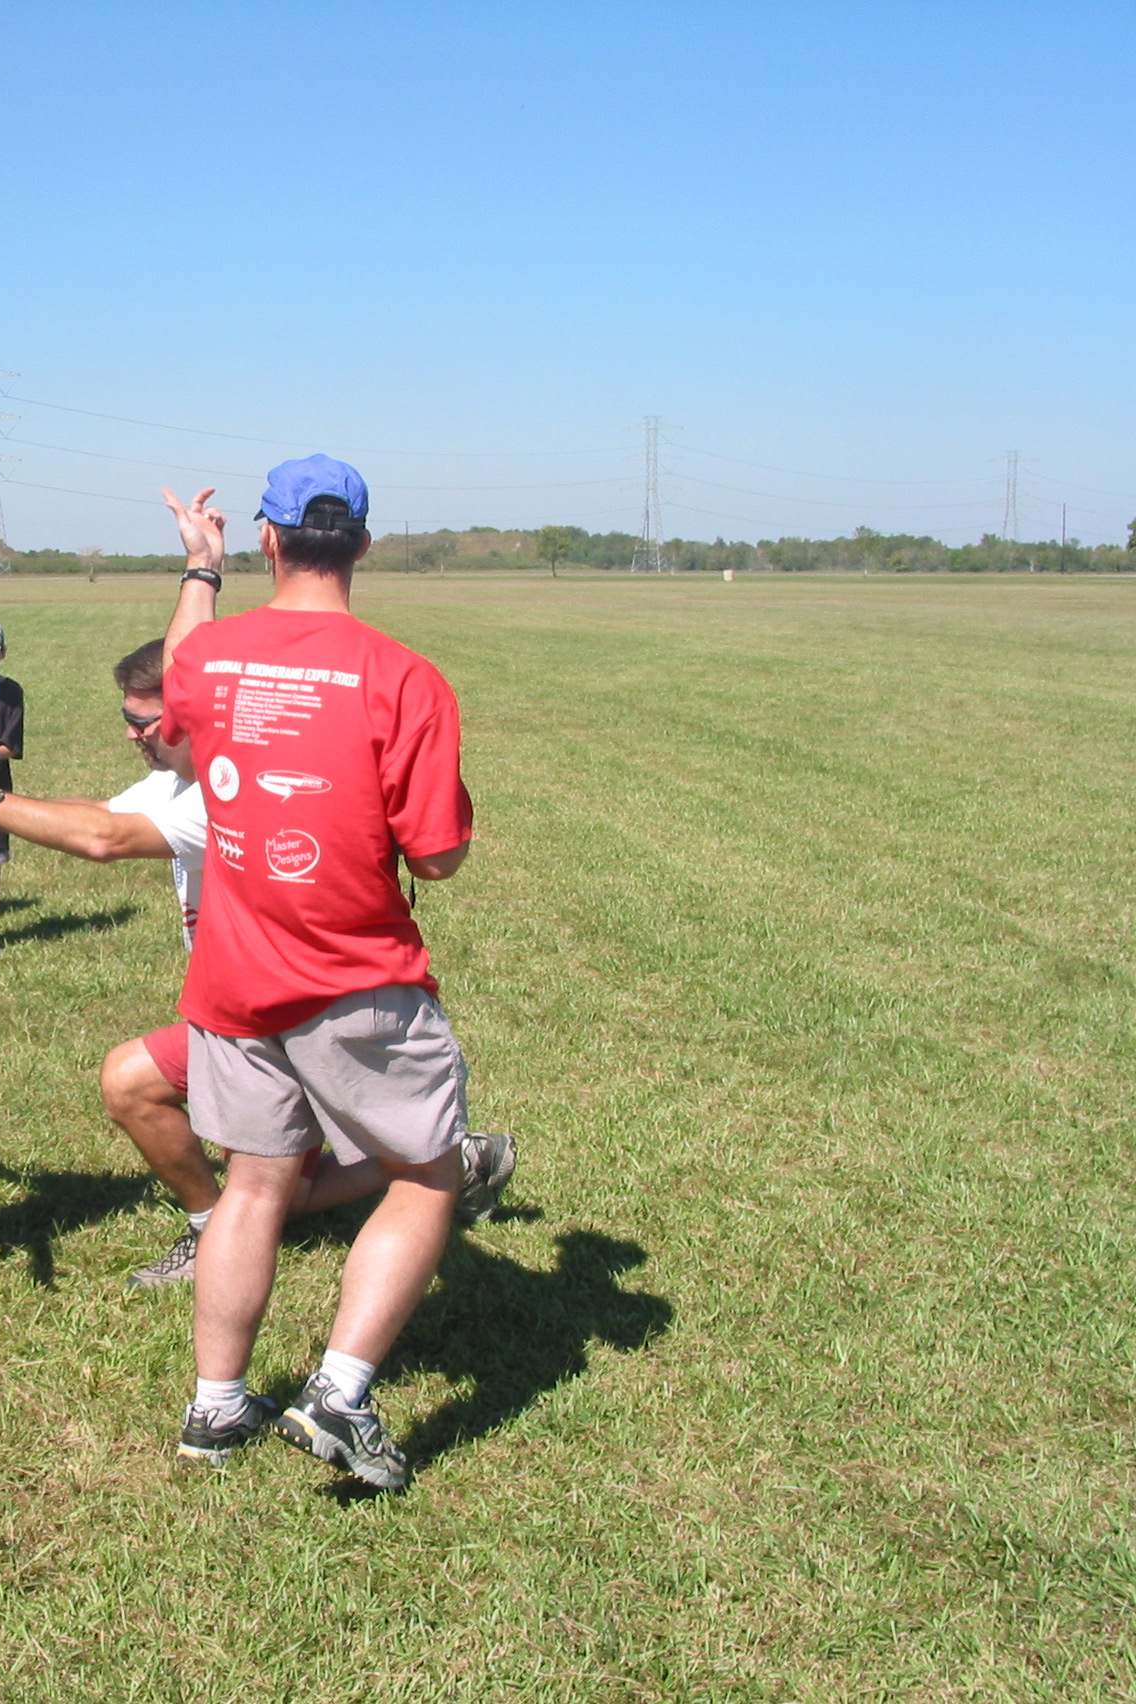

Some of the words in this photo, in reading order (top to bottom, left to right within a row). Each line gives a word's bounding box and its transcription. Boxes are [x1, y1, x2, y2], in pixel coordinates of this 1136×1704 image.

[203, 660, 243, 675] NATIONAL
[245, 662, 305, 681] BOOMERANG
[304, 668, 331, 683] EXPO
[331, 670, 360, 688] 2003
[265, 837, 303, 853] Master
